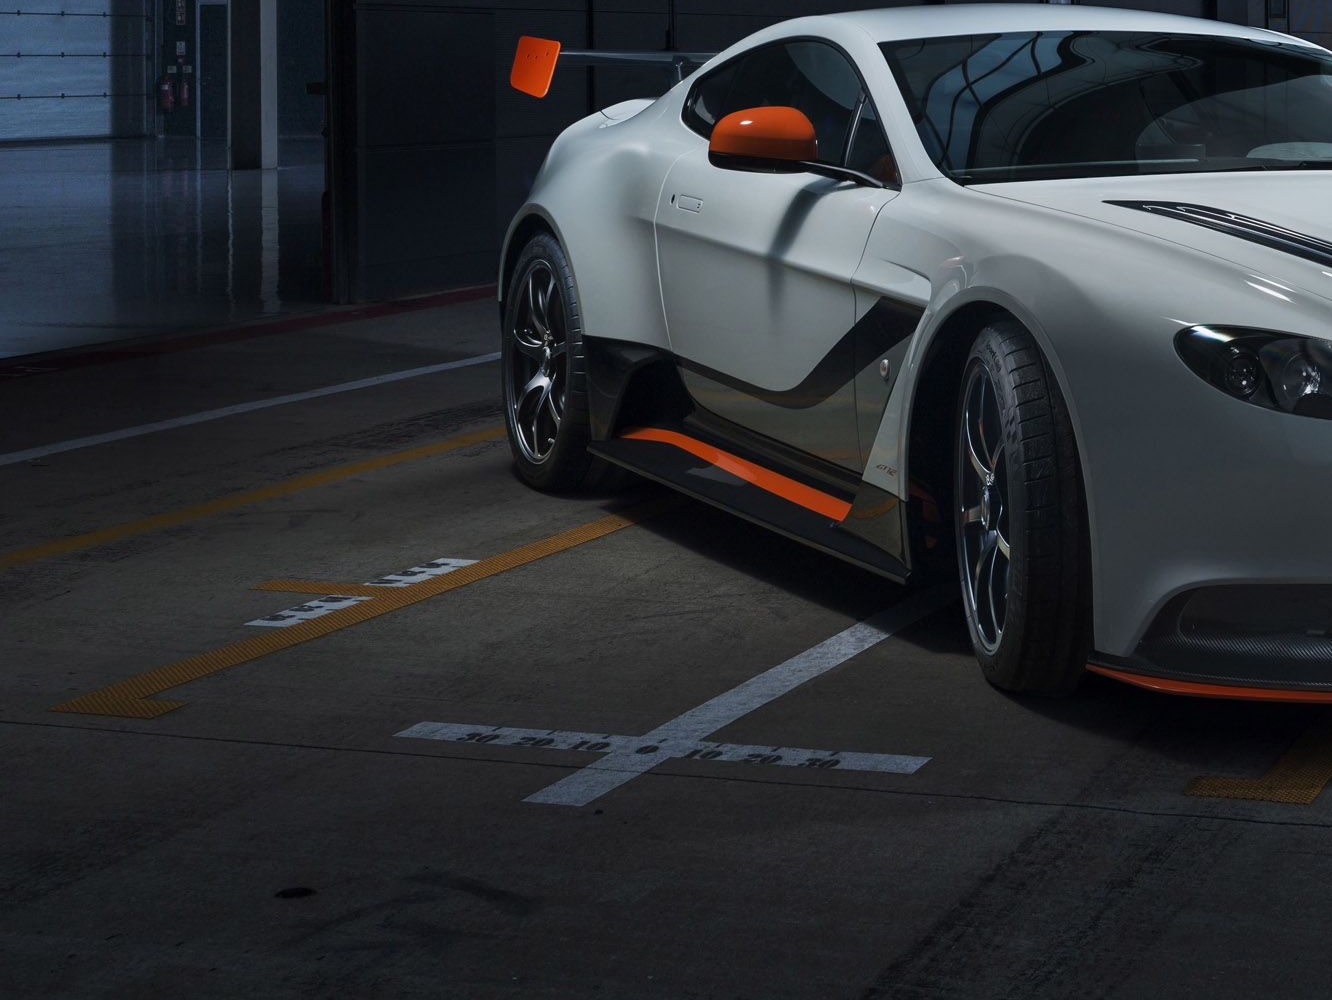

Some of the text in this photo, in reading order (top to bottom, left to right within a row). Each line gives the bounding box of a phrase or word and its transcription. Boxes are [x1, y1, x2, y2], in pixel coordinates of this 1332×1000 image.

[456, 732, 841, 769] 30 20 10 0 10 20 30
